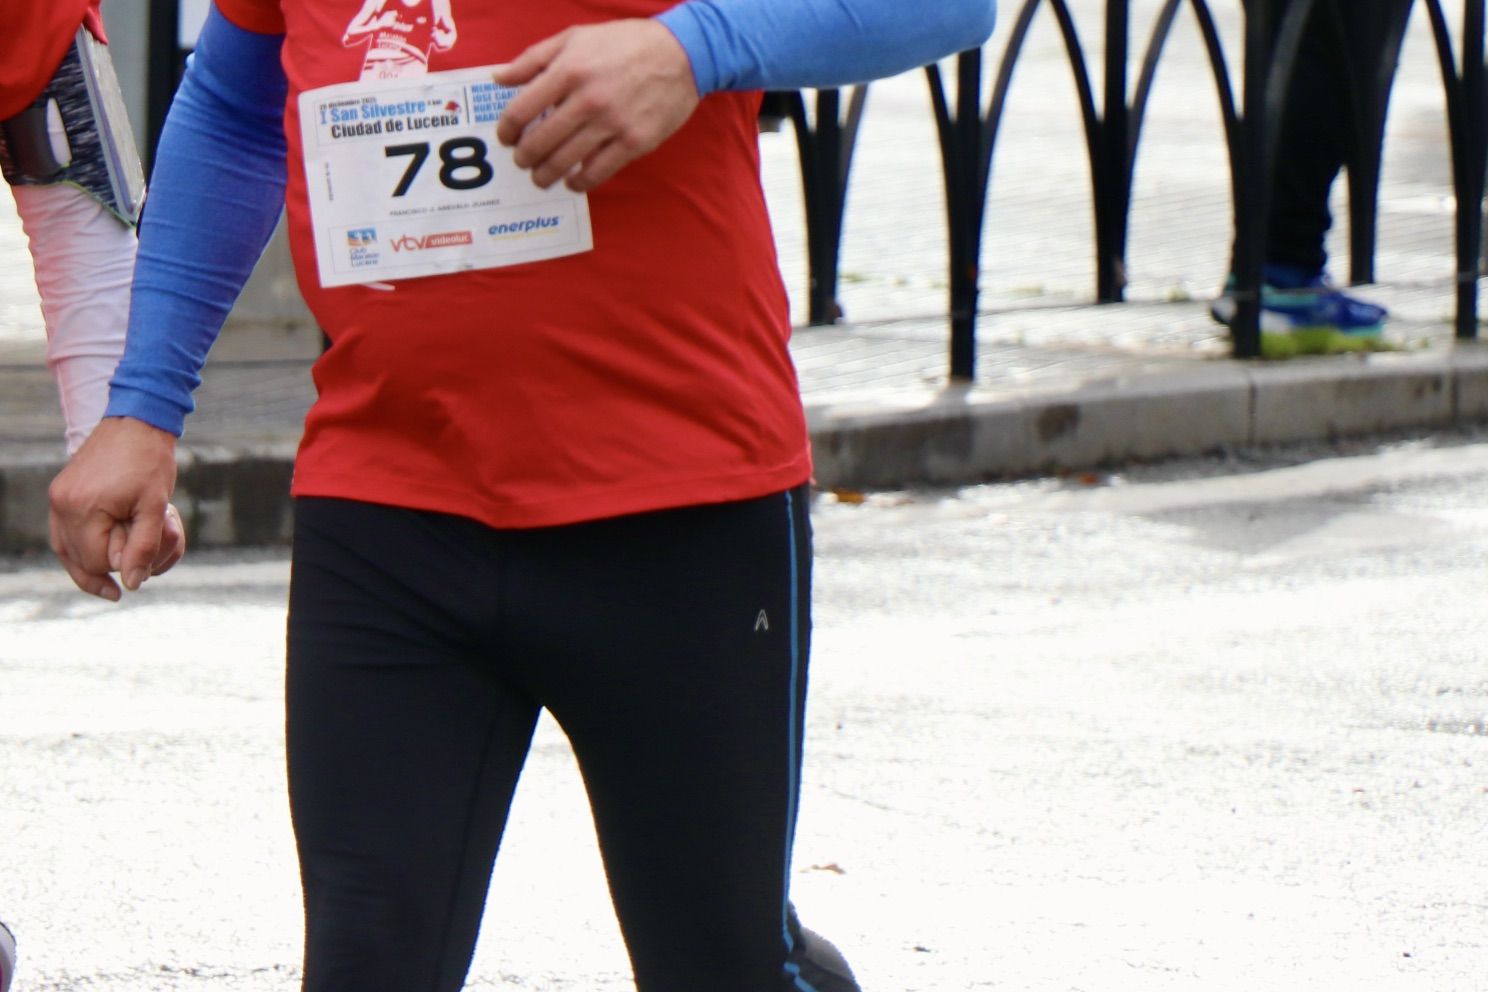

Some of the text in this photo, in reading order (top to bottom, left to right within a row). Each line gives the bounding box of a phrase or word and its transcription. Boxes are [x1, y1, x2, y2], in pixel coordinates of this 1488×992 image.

[320, 110, 327, 125] I
[331, 108, 358, 123] San
[361, 100, 426, 119] Silvestre
[331, 114, 459, 139] Ciudad de Lucena
[384, 136, 494, 198] 78
[488, 215, 560, 236] enerplus
